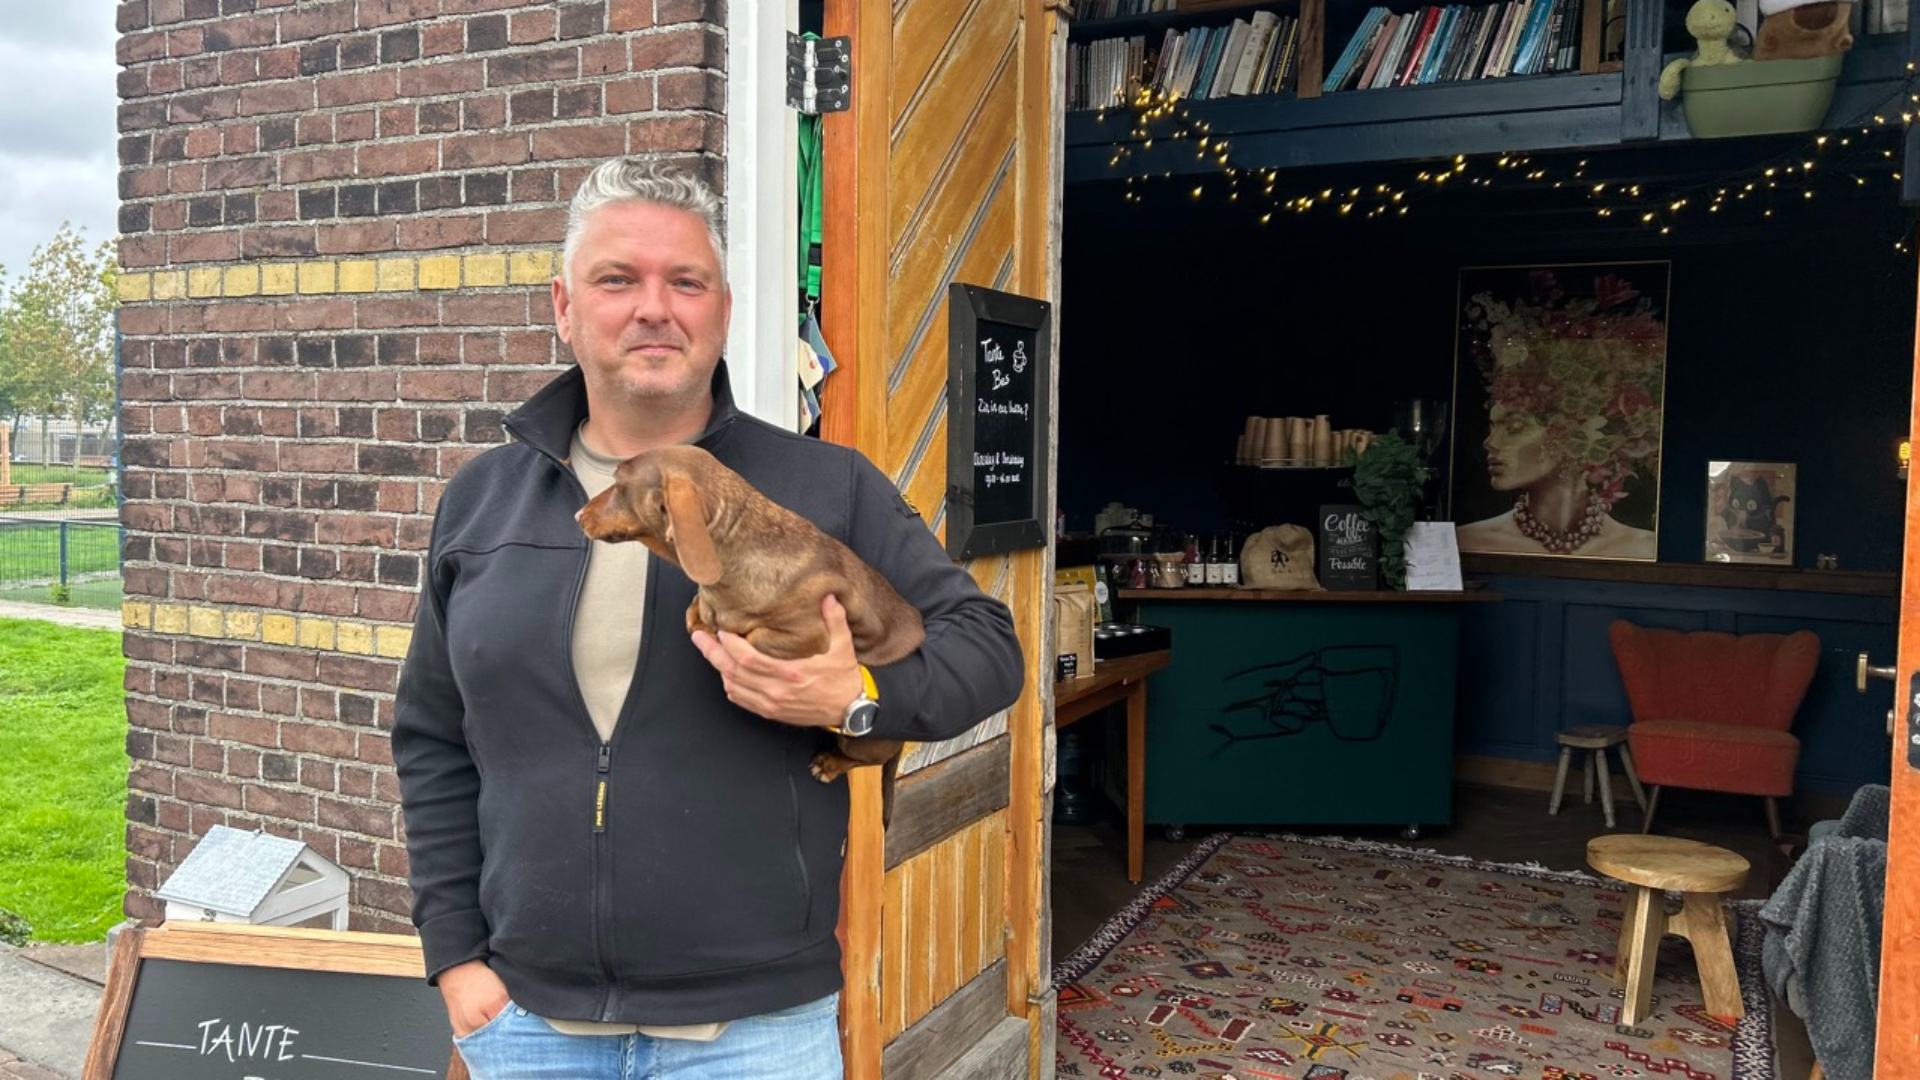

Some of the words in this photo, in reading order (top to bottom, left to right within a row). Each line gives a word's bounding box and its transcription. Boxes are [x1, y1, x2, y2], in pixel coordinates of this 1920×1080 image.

[1325, 513, 1369, 538] Coffee
[1328, 557, 1367, 570] Possible
[198, 1018, 299, 1063] TANTE
